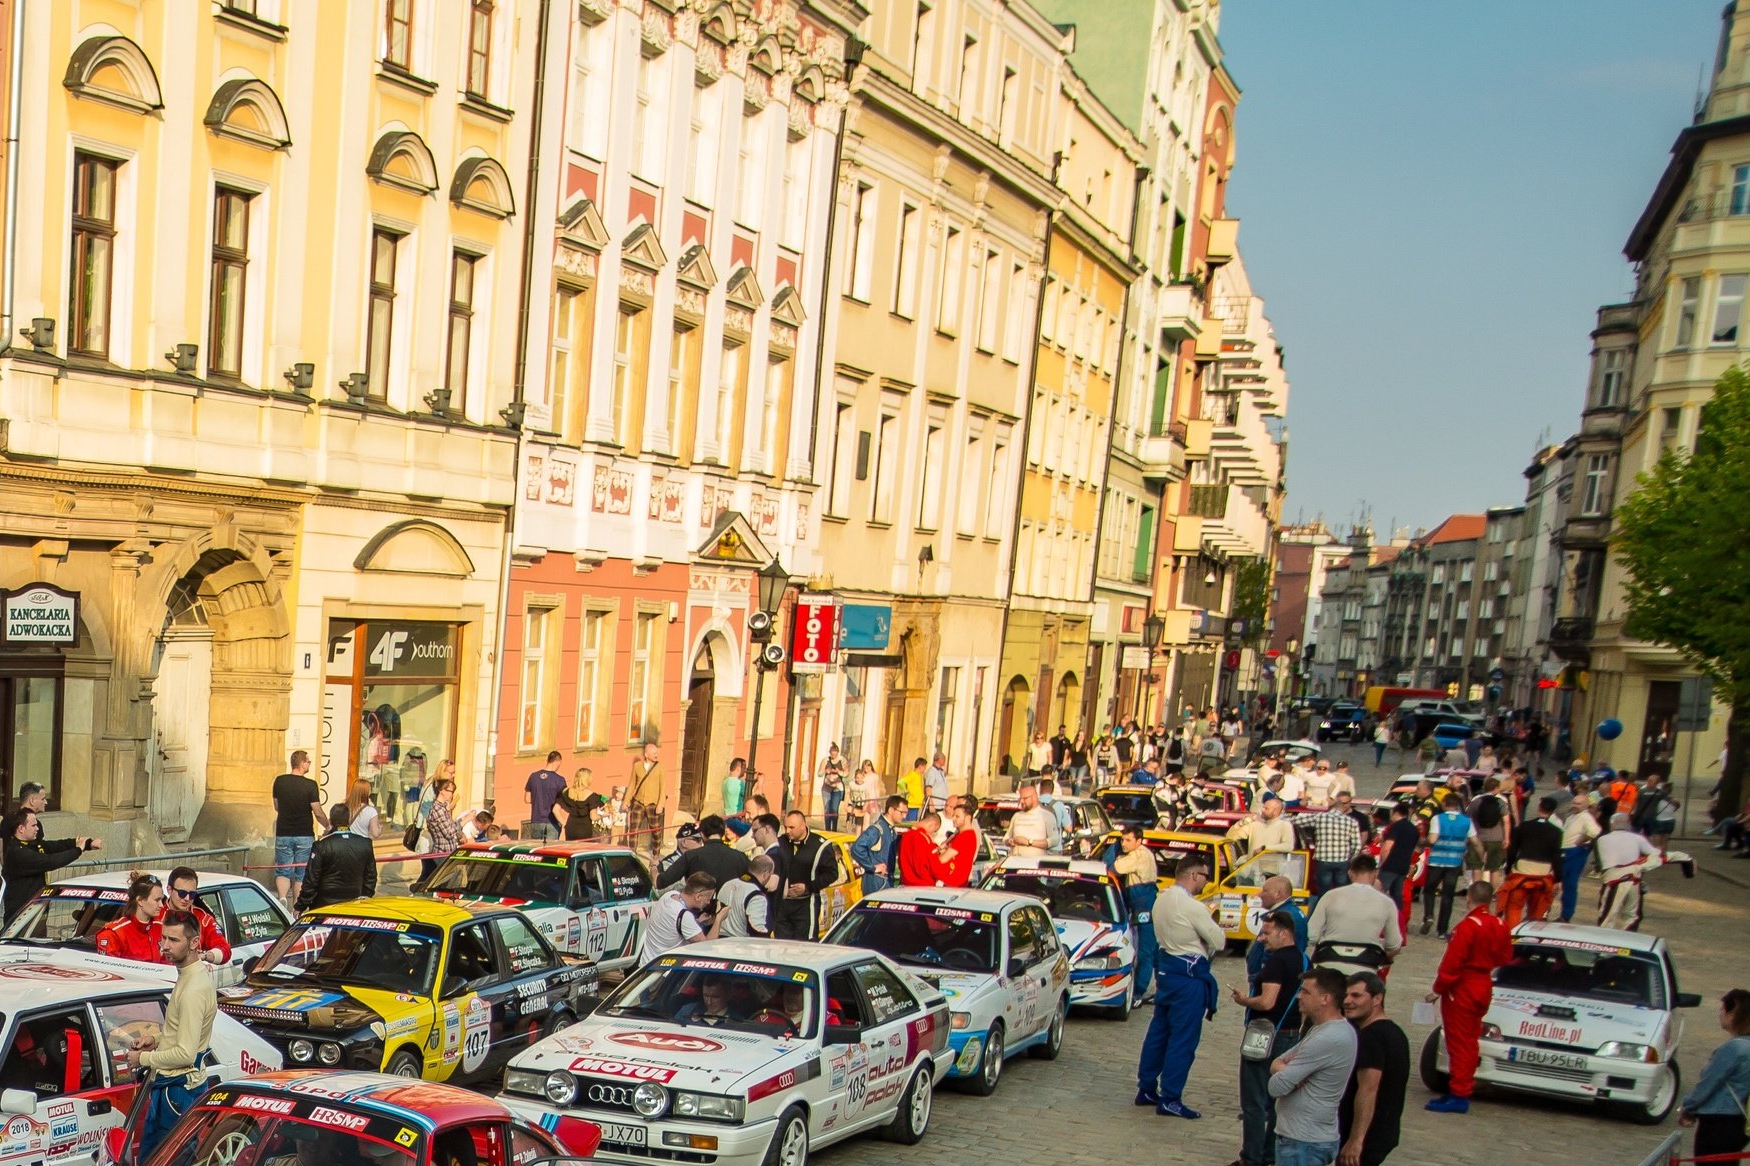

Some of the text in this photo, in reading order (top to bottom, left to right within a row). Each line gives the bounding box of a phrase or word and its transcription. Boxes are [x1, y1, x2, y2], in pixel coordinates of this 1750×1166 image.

[10, 607, 71, 623] KANCELARIA
[8, 623, 72, 638] ADWOKACKA
[804, 605, 821, 662] FOTO
[369, 631, 453, 671] 4F outhorn
[60, 888, 96, 898] MOTUL
[880, 902, 917, 912] MOTUL
[323, 917, 361, 926] MOTUL
[589, 933, 604, 953] 112
[683, 960, 725, 970] MOTUL
[517, 979, 547, 998] SECURITY
[521, 995, 548, 1015] GENERAL
[1519, 1021, 1582, 1044] RedLine.pl
[465, 1030, 488, 1059] 107
[627, 1033, 719, 1052] Audi
[571, 1059, 673, 1082] MOTUL
[869, 1056, 904, 1082] auto
[269, 1083, 368, 1103] SOPOT
[847, 1072, 866, 1104] 108
[49, 1104, 74, 1117] MOTUL
[210, 1092, 229, 1101] 104
[239, 1097, 293, 1113] MOTUL
[12, 1123, 30, 1134] 2018
[53, 1123, 78, 1137] KRAUSE
